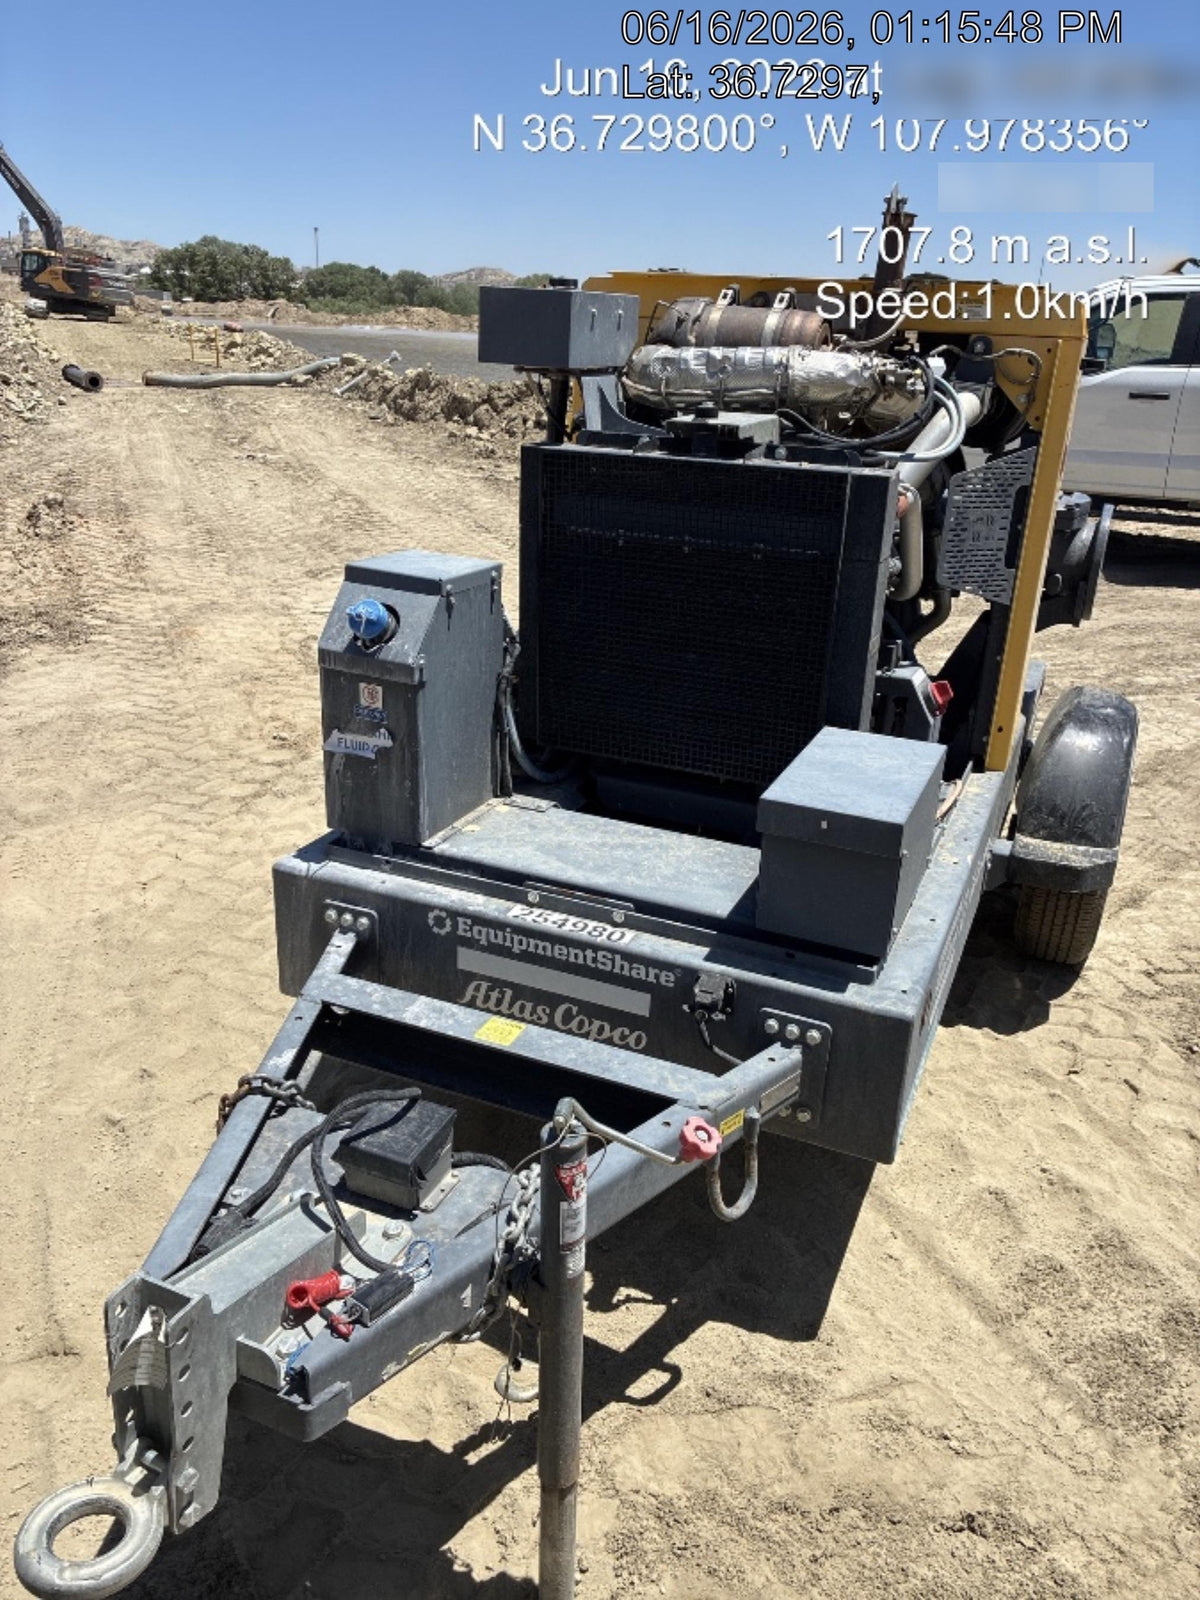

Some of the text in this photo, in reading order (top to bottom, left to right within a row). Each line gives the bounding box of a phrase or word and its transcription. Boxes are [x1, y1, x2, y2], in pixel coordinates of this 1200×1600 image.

[456, 916, 676, 988] EquipmentShare
[511, 907, 628, 943] 254980
[458, 980, 550, 1027] Atlas
[553, 1002, 649, 1051] Copco
